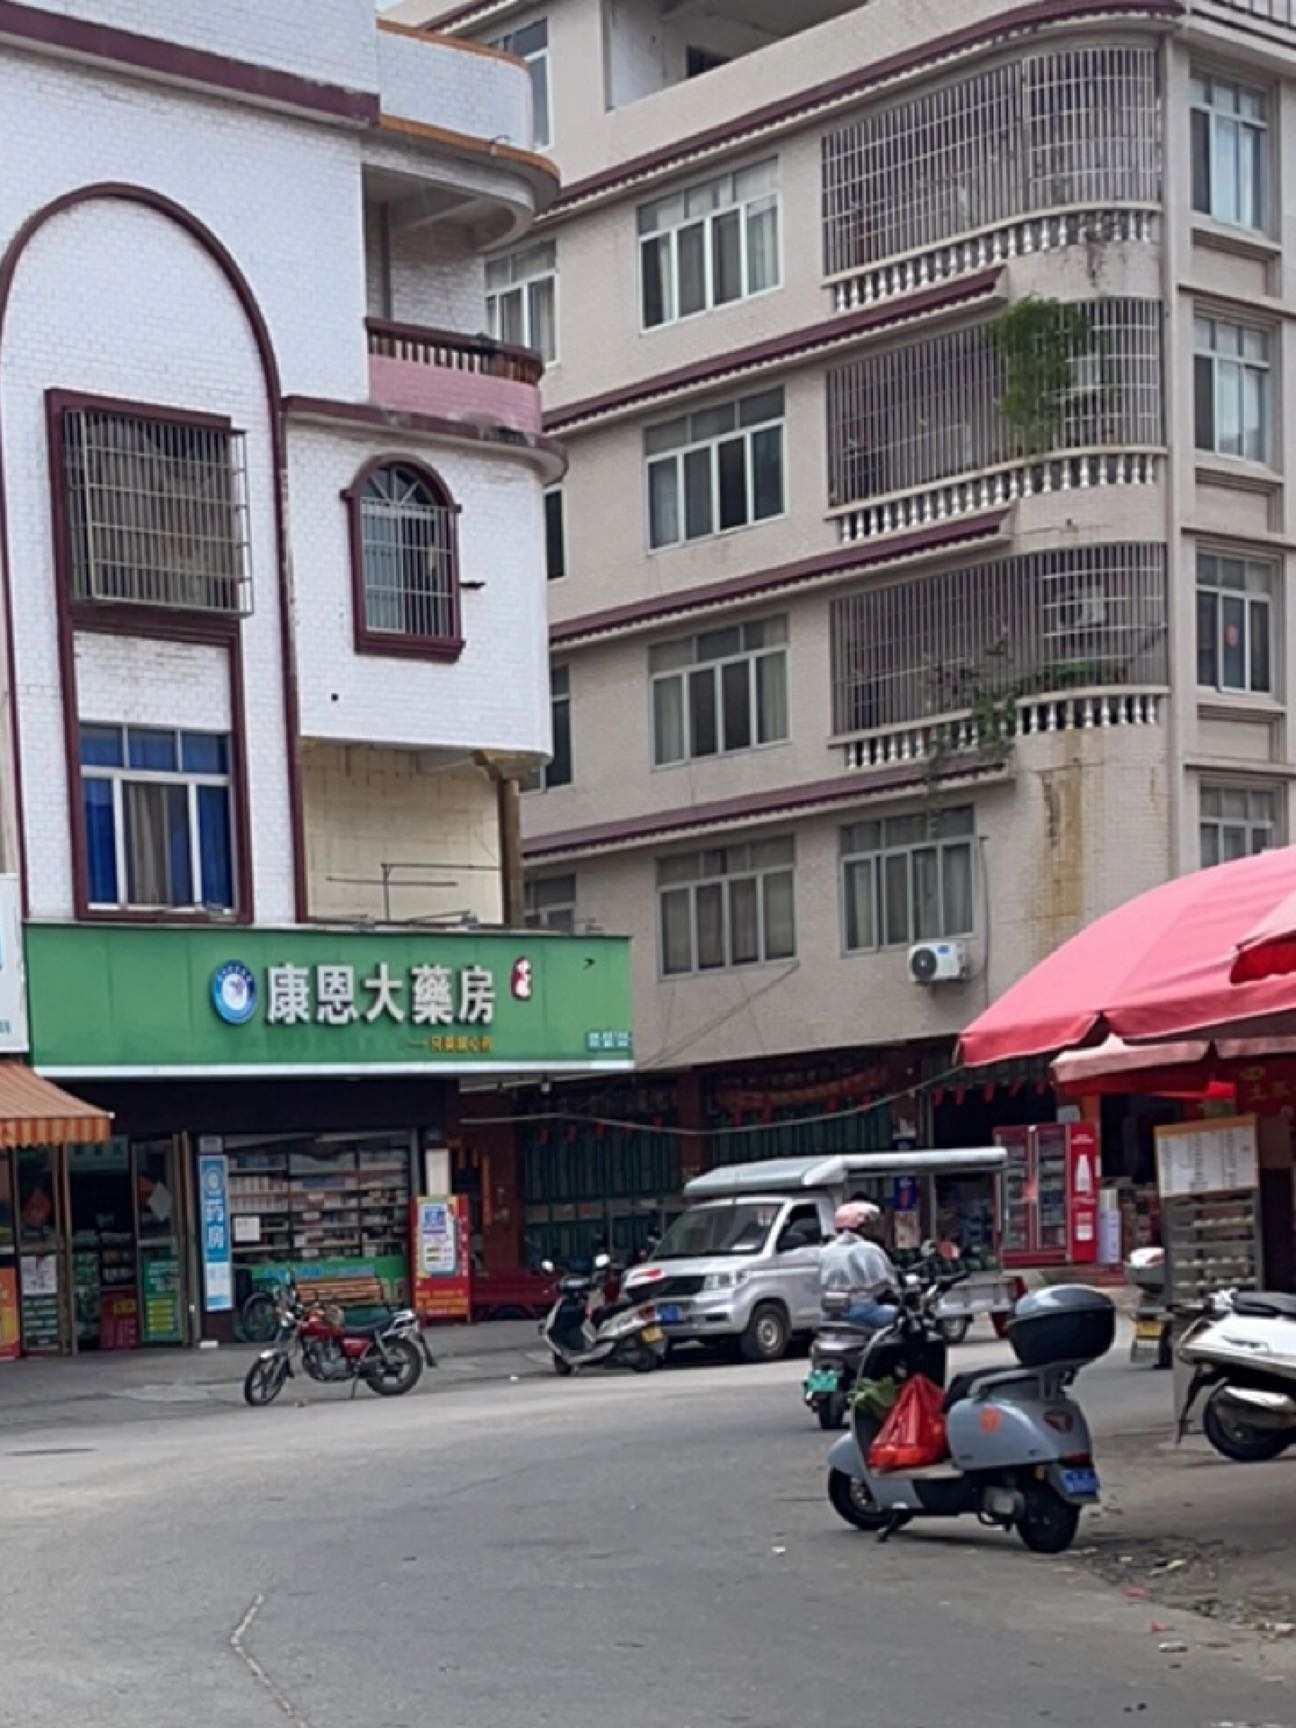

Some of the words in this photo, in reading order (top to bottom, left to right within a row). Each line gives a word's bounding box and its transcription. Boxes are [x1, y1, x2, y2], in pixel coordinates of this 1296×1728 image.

[267, 962, 496, 1025] 康恩大藥房
